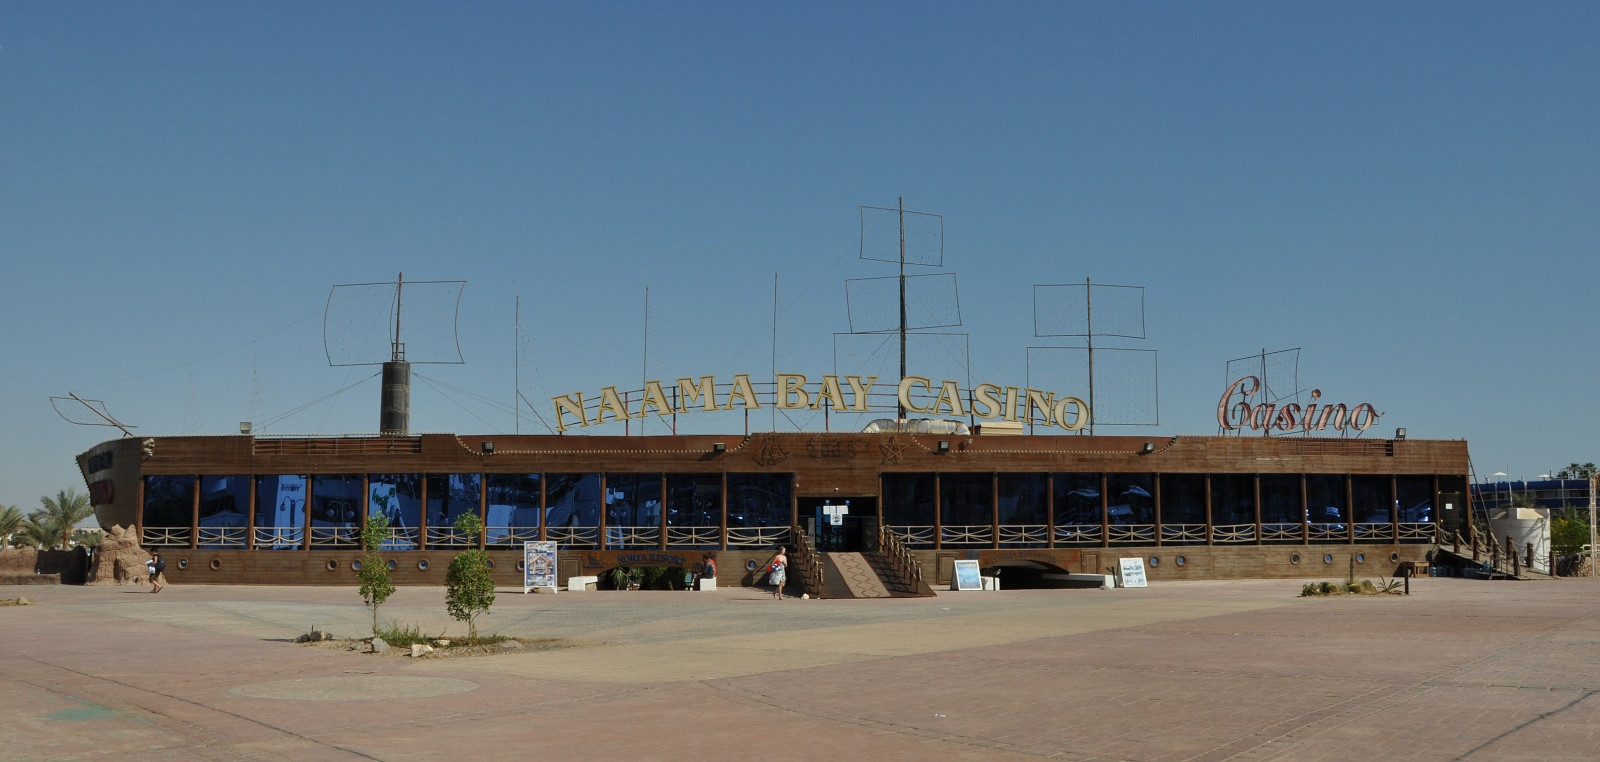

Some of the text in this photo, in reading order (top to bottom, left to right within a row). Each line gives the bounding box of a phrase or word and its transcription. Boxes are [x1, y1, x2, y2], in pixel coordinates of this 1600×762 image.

[550, 373, 1090, 432] NAAMA BAY CASINO
[1217, 375, 1385, 431] Casino
